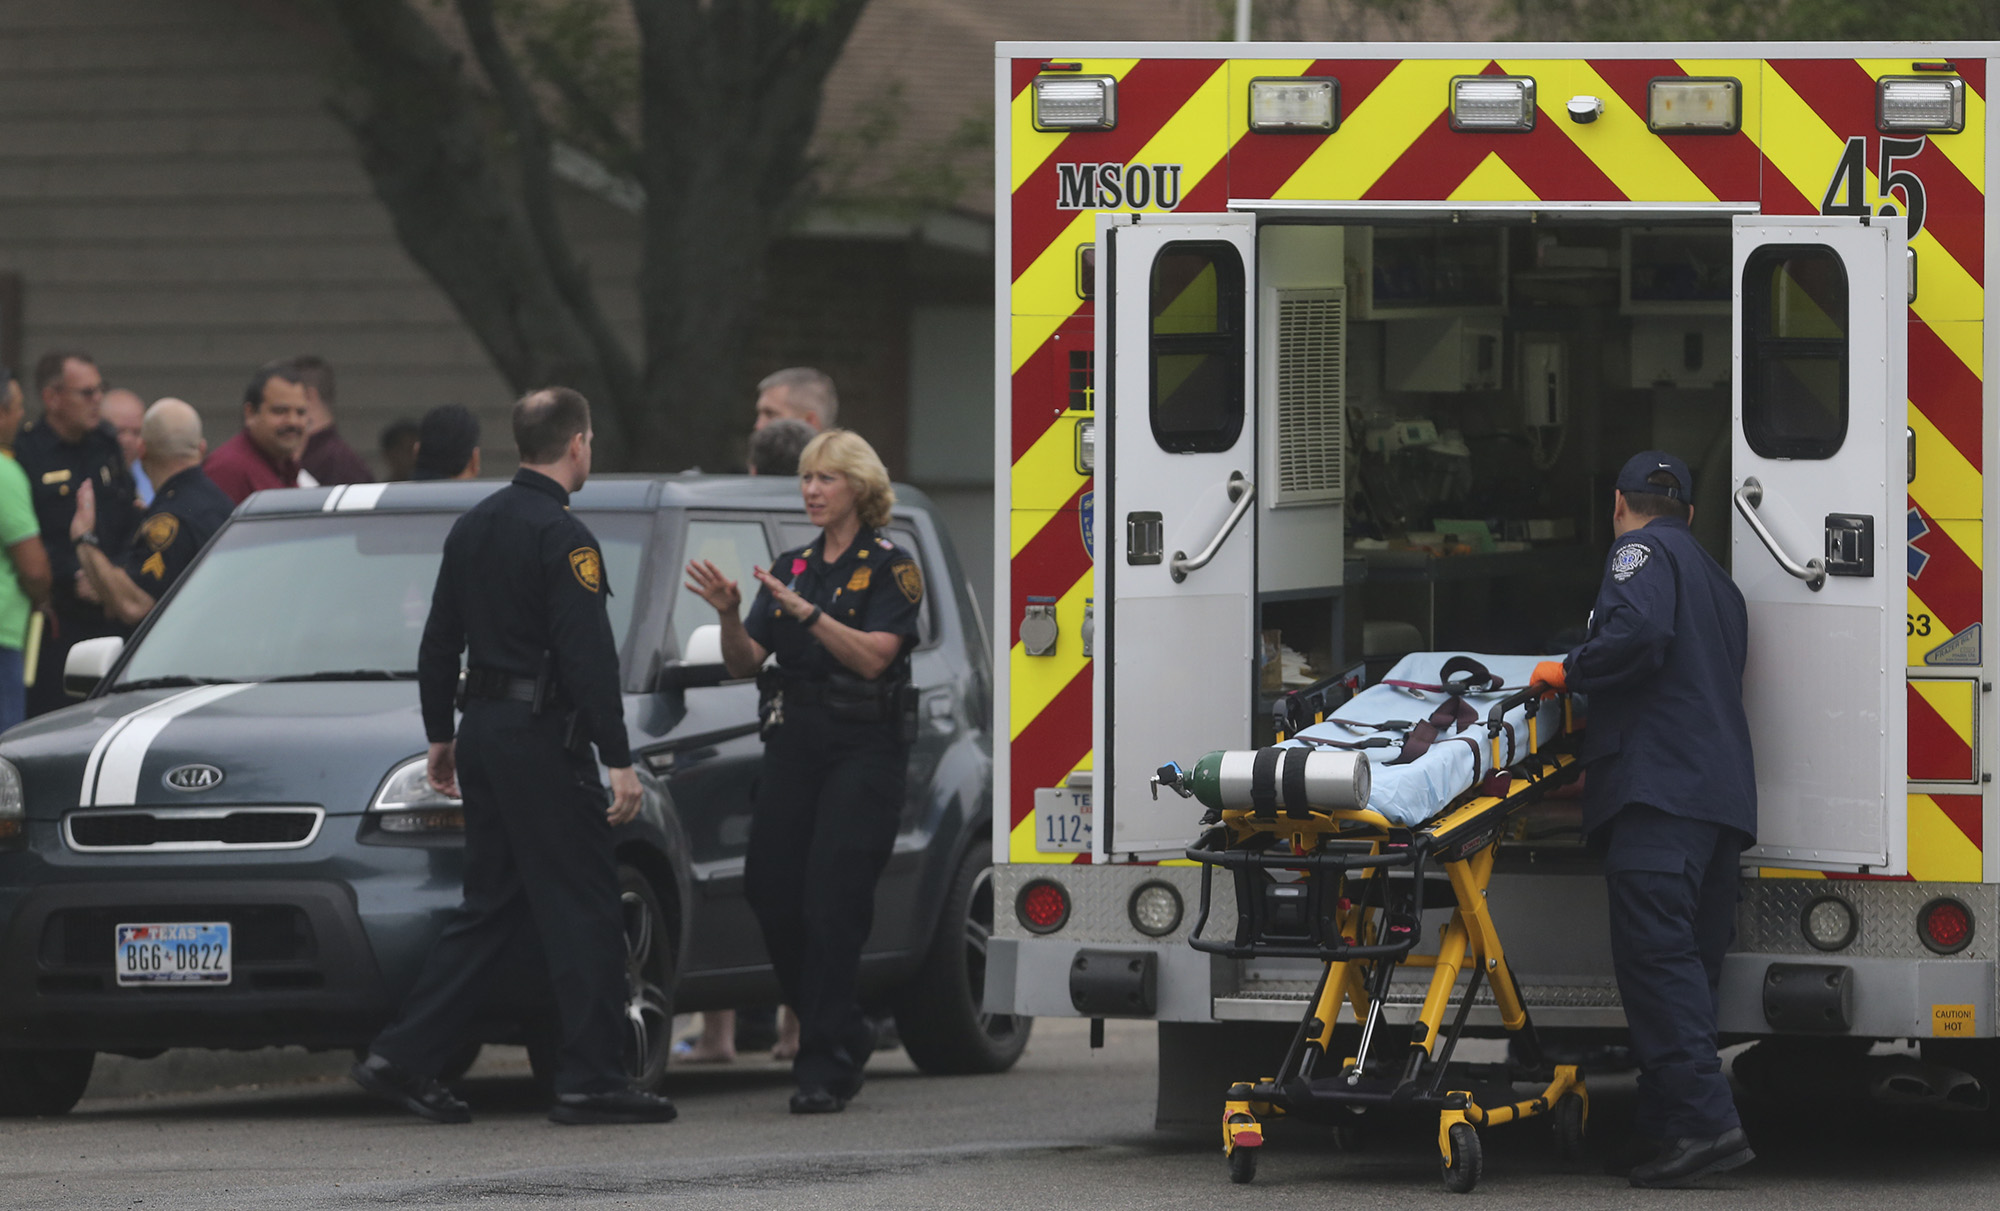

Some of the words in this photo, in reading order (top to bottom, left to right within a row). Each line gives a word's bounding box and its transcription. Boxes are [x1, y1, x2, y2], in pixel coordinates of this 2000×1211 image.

[1056, 162, 1183, 210] MSOU
[1820, 135, 1927, 241] 45
[176, 769, 212, 786] KIA
[1046, 814, 1082, 843] 112
[148, 927, 197, 940] TEXAS
[1935, 1010, 1972, 1019] CAUTION!
[1944, 1021, 1962, 1032] HOT
